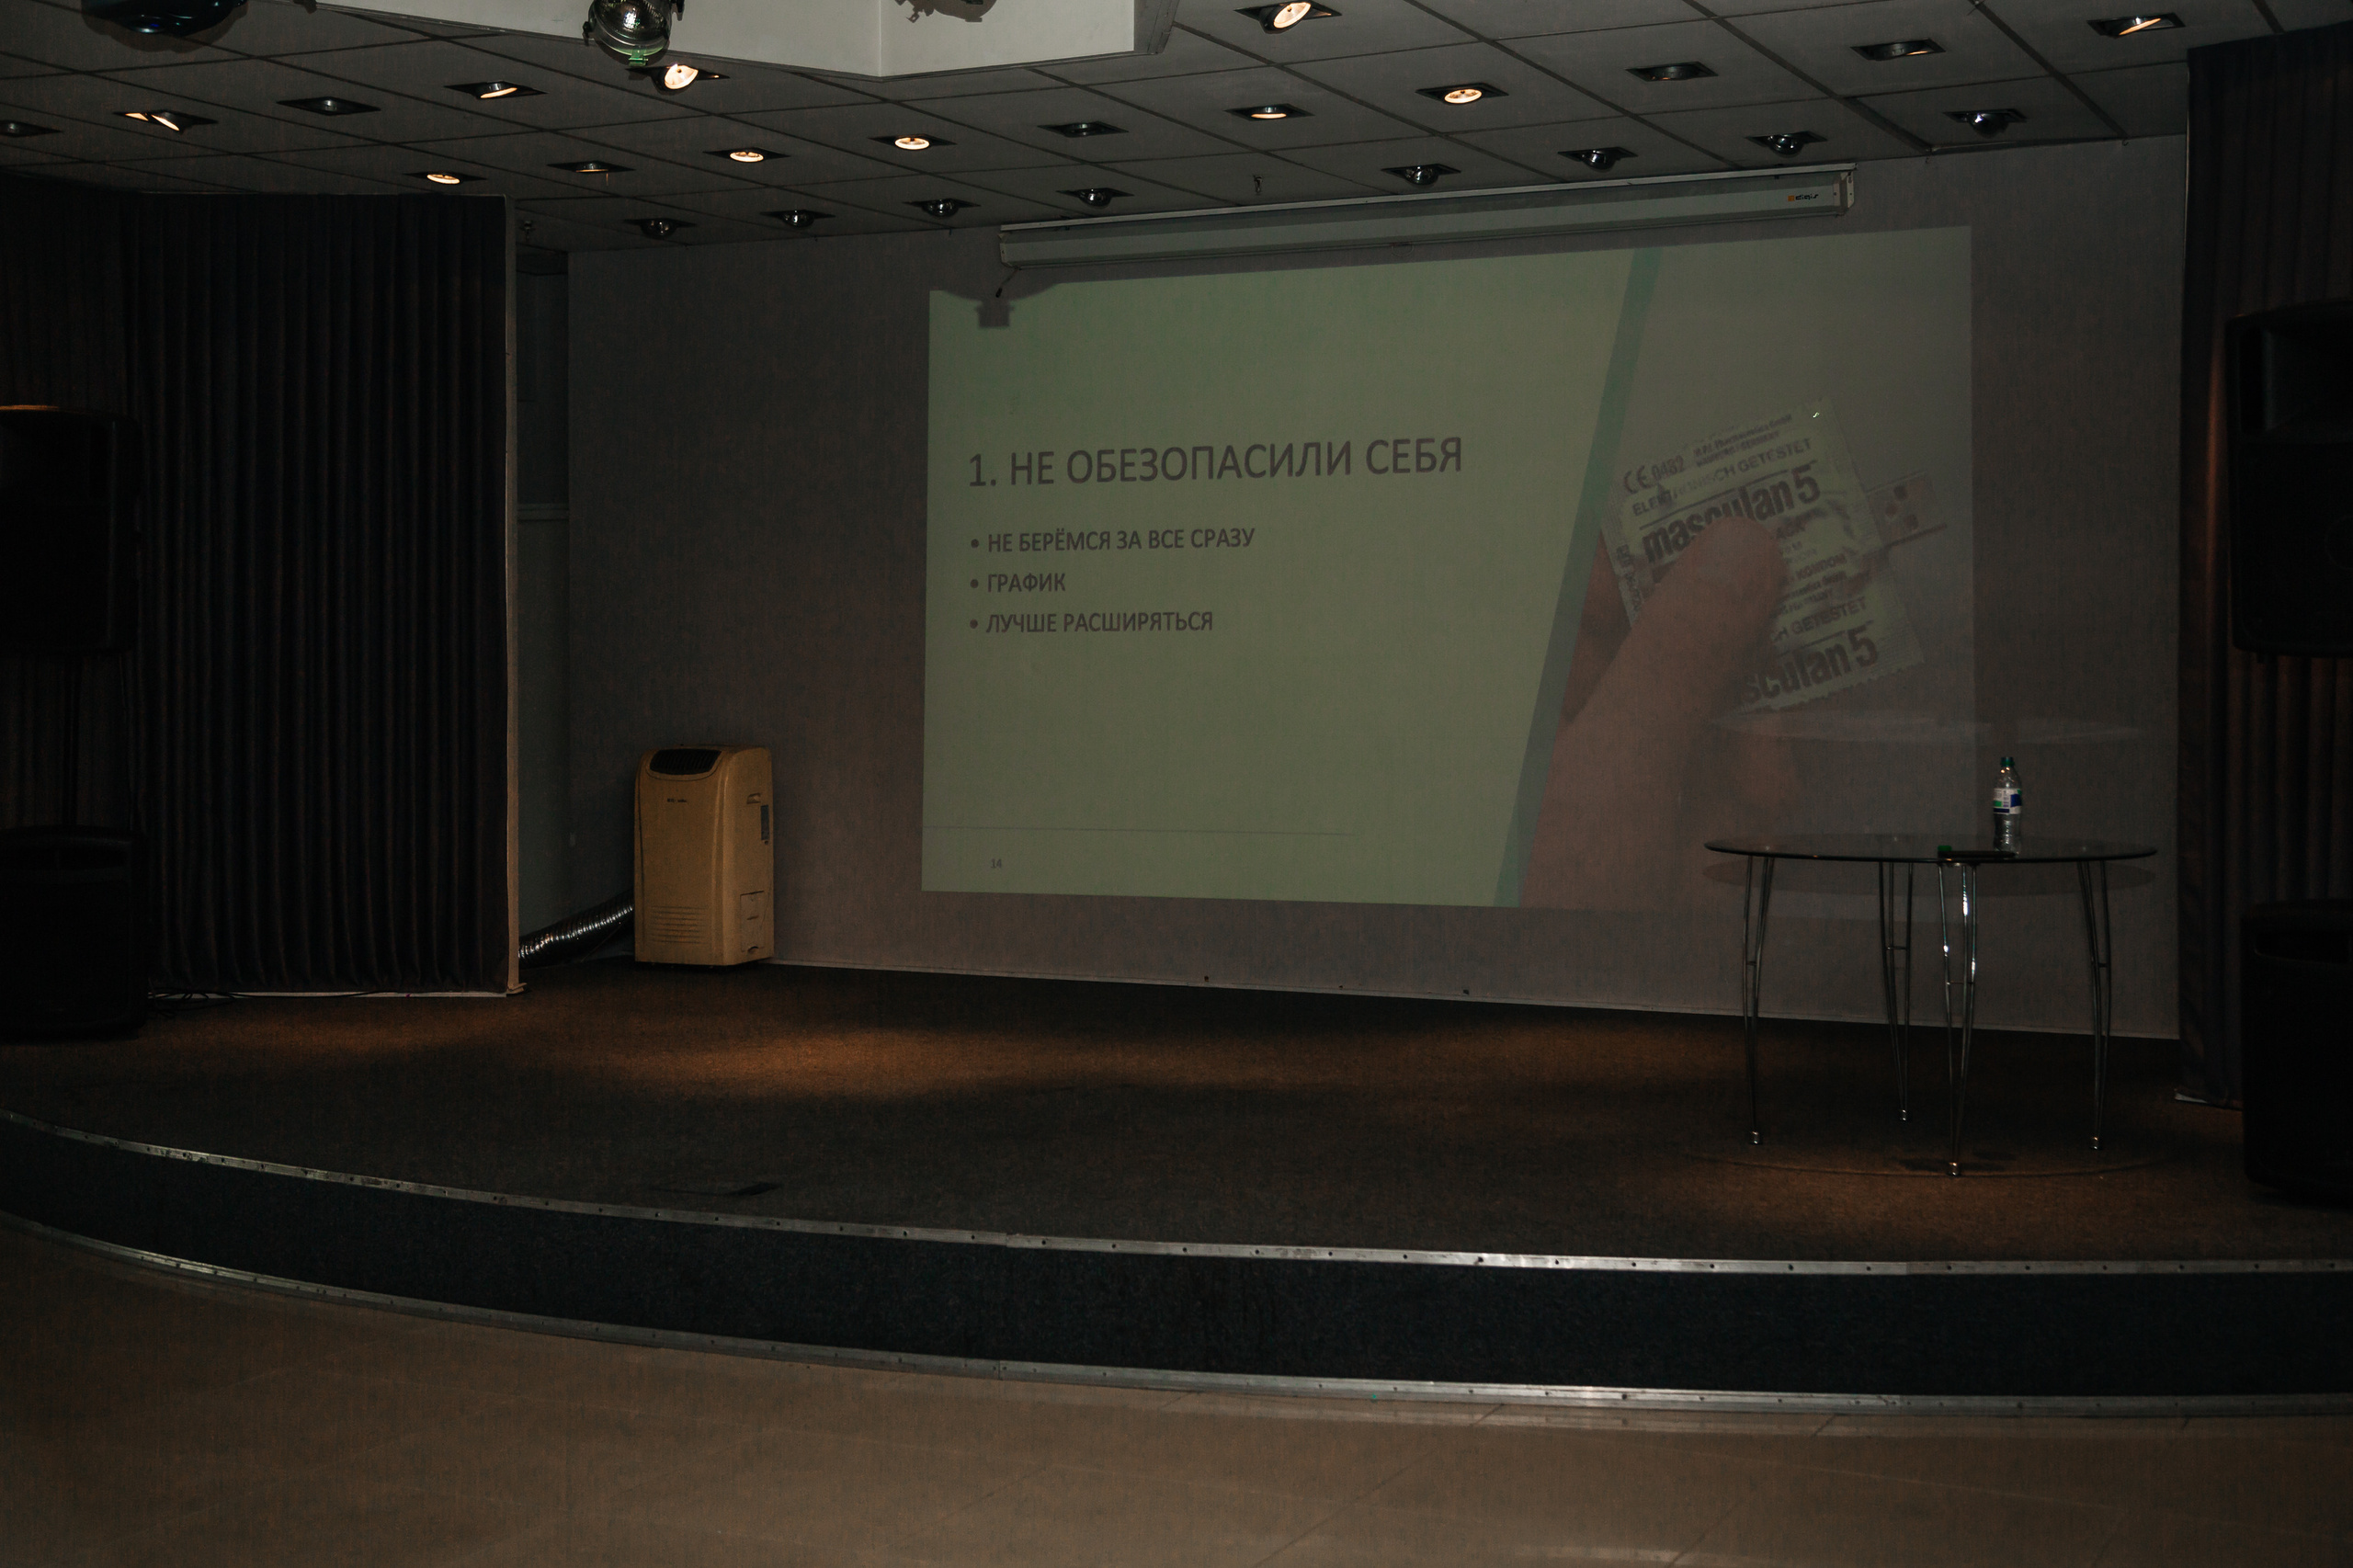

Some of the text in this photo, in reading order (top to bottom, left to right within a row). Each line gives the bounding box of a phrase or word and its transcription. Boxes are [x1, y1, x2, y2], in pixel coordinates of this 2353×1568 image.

[969, 437, 1462, 486] 1. НЕ ОБЕЗОПАСИЛИ СЕБЯ
[1791, 463, 1821, 505] 5
[988, 528, 1256, 552] НЕ БЕРЁМСЯ ЗА ВСЕ СРАЗУ
[987, 573, 1066, 593] ГРАФИК
[985, 611, 1213, 633] ЛУЧШЕ РАСШИРЯТЬСЯ
[1847, 625, 1879, 667] 5
[990, 858, 1002, 869] 14
